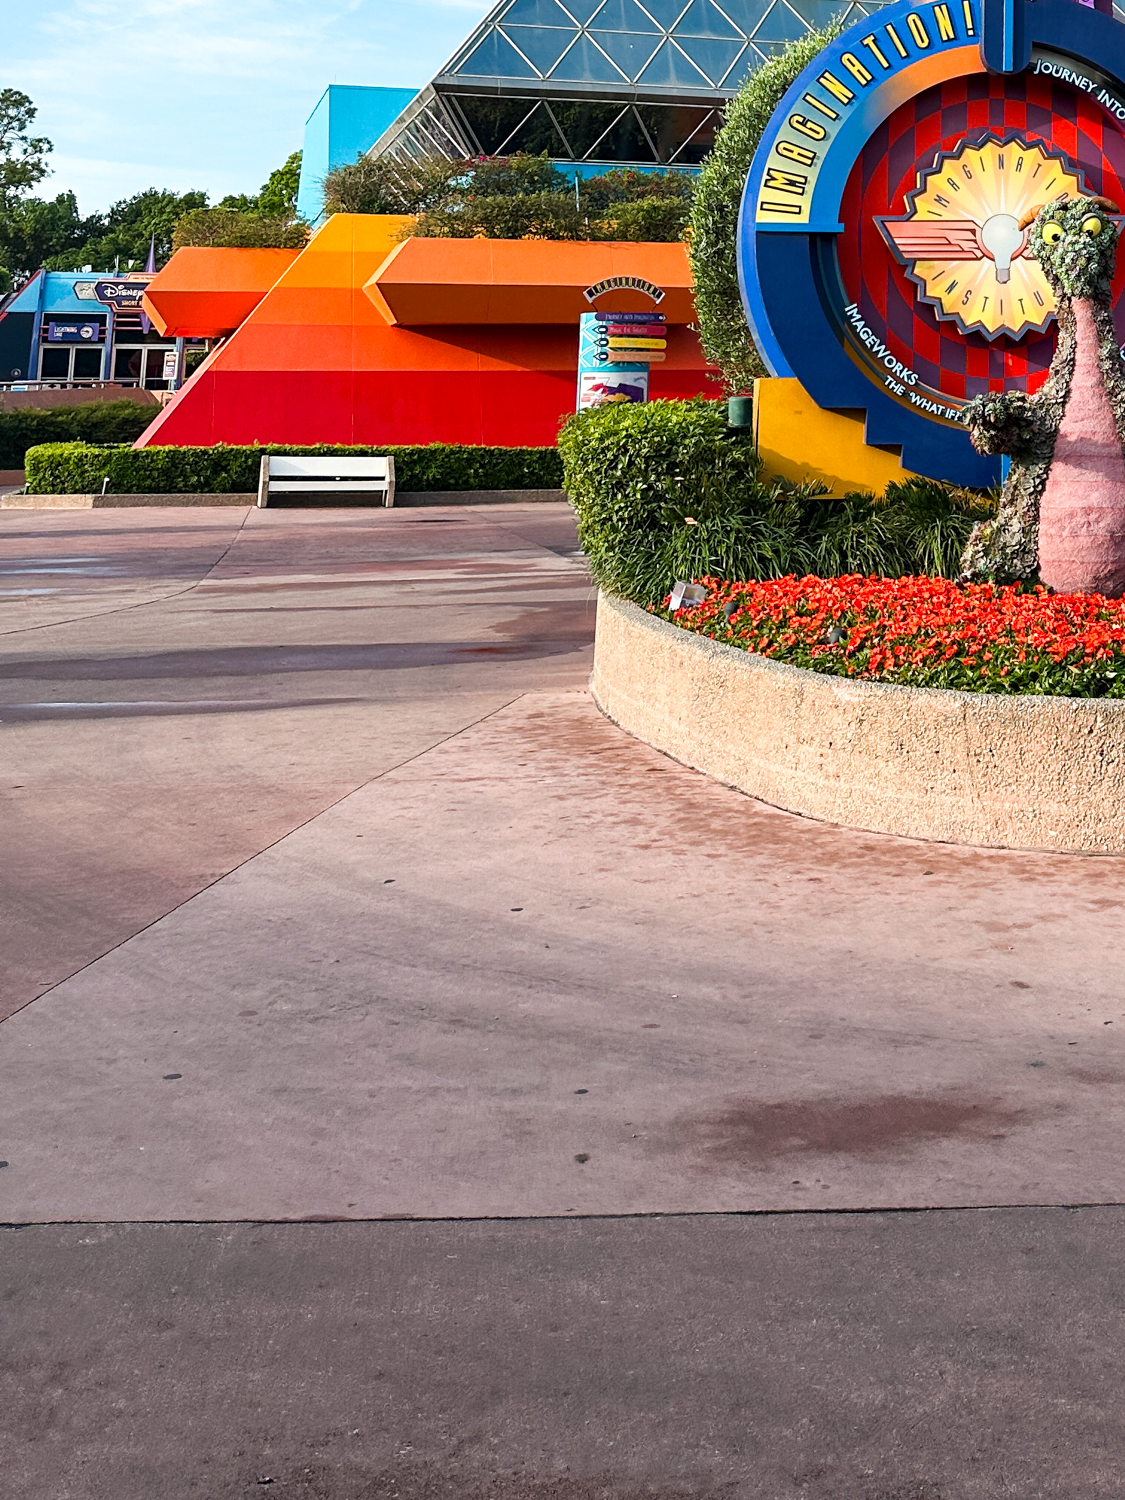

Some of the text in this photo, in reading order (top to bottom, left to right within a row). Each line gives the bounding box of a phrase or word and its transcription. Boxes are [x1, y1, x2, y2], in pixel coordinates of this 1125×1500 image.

[1033, 58, 1098, 93] JOURNEY
[927, 153, 1069, 217] IMAGINATIO
[932, 270, 1045, 315] INSTITU
[845, 303, 918, 386] IMAGEWORKS
[884, 375, 906, 397] THE
